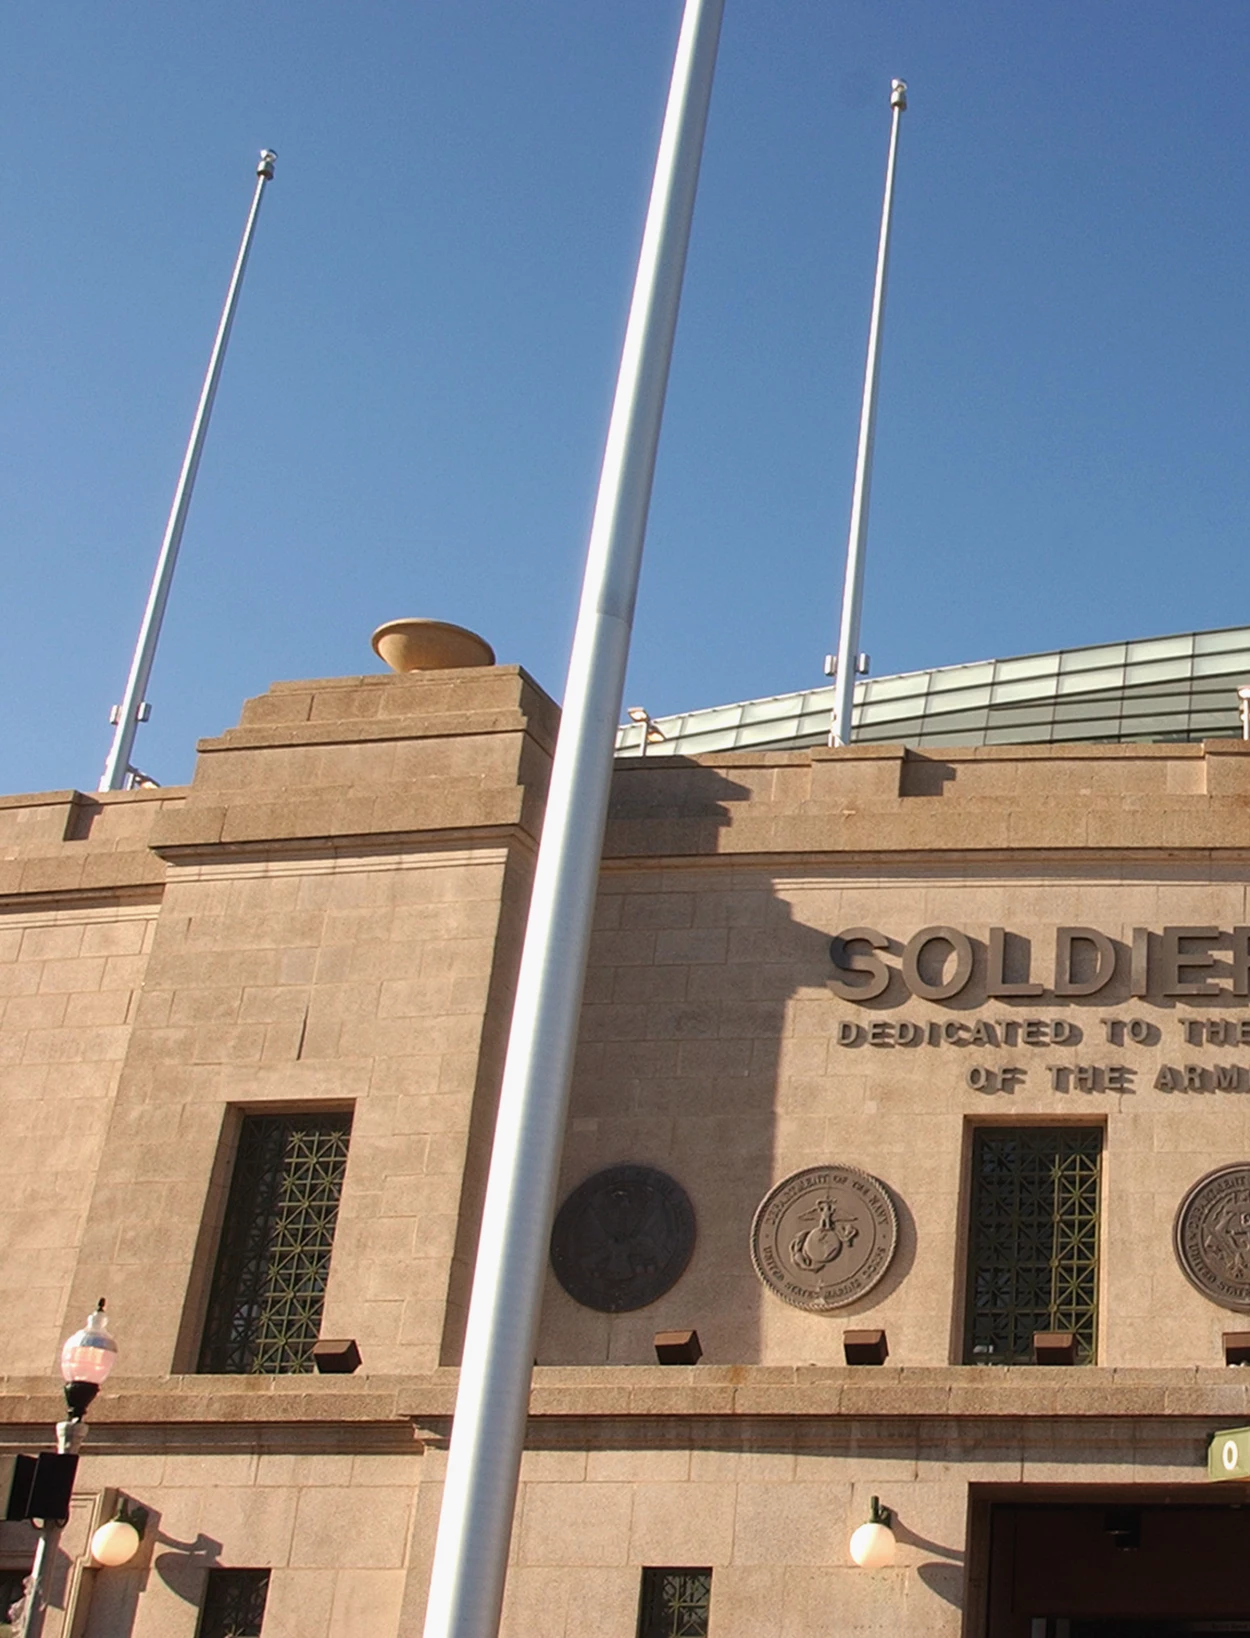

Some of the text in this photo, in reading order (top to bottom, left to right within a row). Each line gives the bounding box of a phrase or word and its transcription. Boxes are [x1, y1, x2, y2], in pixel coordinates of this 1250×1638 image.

[836, 1018, 1073, 1046] DEDICATED
[1100, 1018, 1150, 1044] TO
[966, 1064, 1021, 1092] OF
[1046, 1063, 1127, 1091] THE
